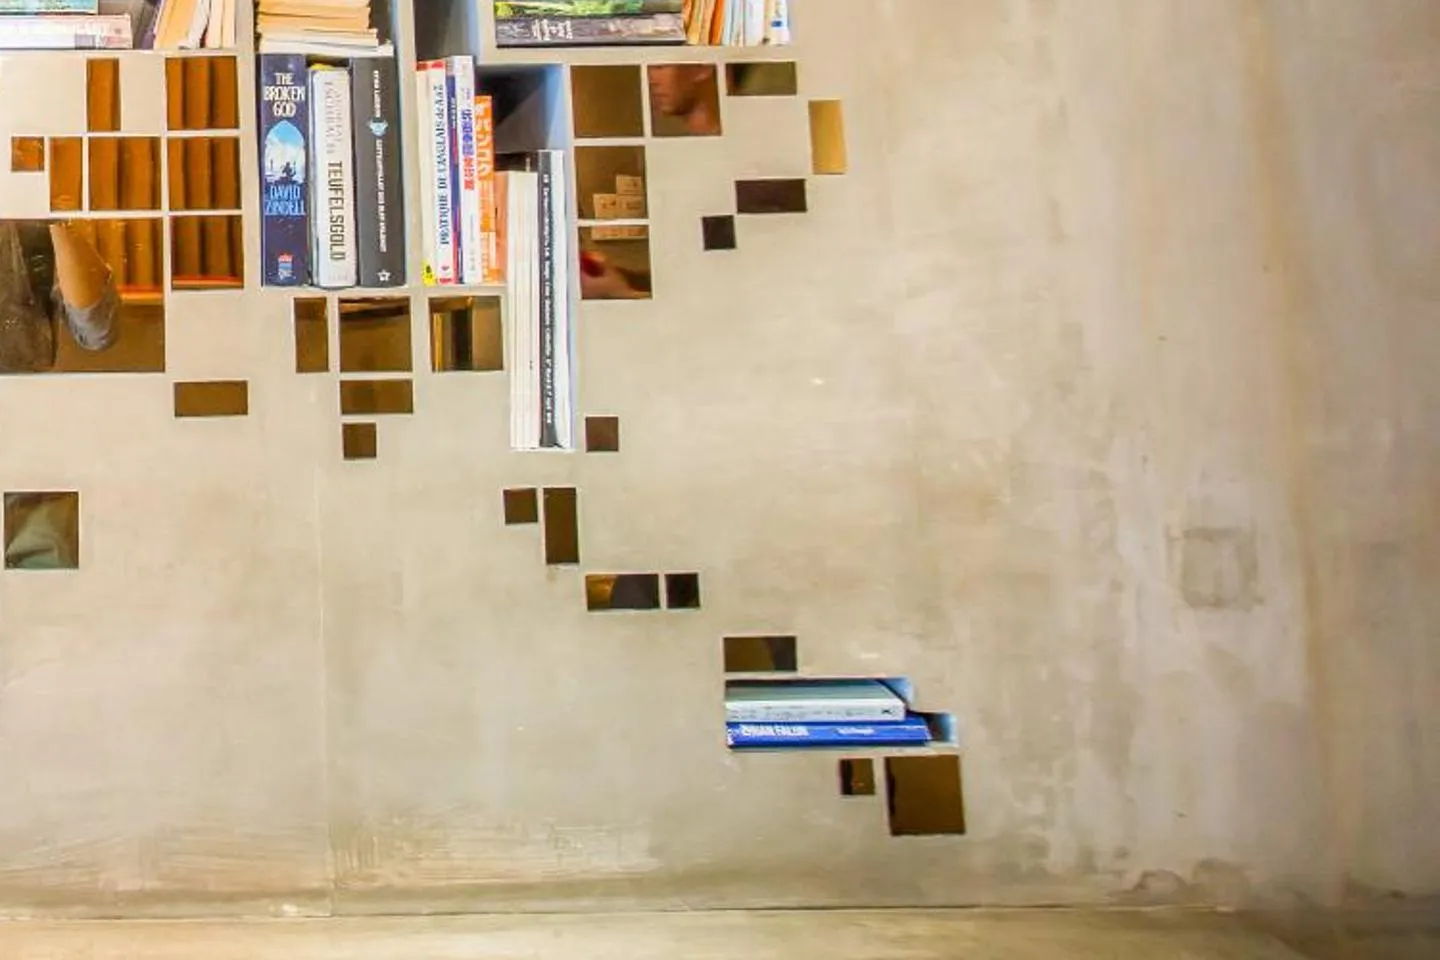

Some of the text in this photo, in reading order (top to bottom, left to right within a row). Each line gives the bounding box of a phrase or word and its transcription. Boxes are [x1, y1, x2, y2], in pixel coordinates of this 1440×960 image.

[273, 72, 295, 86] THE
[263, 86, 306, 102] BROKEN
[272, 101, 296, 117] GOD
[269, 185, 301, 200] DAVID
[327, 160, 346, 261] TEUFELSGOLD
